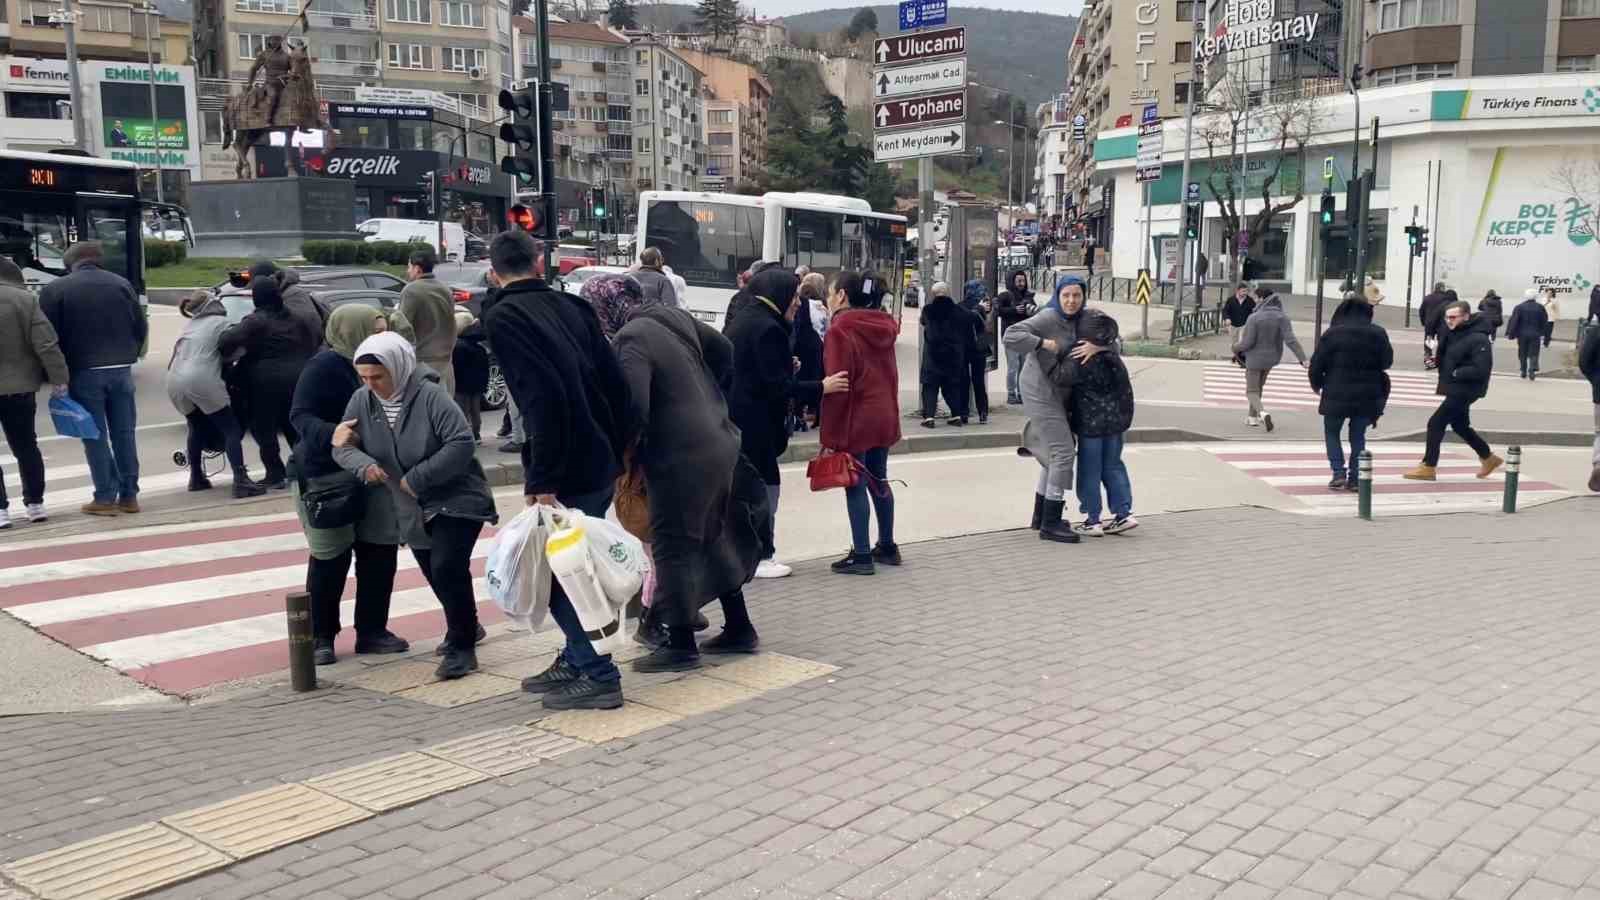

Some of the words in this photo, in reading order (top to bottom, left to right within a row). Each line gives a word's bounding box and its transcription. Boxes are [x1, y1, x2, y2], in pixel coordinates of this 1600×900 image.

[1225, 0, 1275, 27] Hotel
[898, 31, 963, 57] Ulucami
[899, 98, 962, 120] Tophane
[1482, 98, 1530, 111] Türkiye
[1534, 96, 1577, 107] Finans
[877, 139, 899, 151] Kent
[327, 155, 400, 178] arçelik
[468, 166, 491, 185] arçelik
[1518, 204, 1558, 219] BOL
[1489, 220, 1556, 238] KEPÇE
[1486, 236, 1527, 249] Hesap
[1533, 276, 1570, 286] Türkiye
